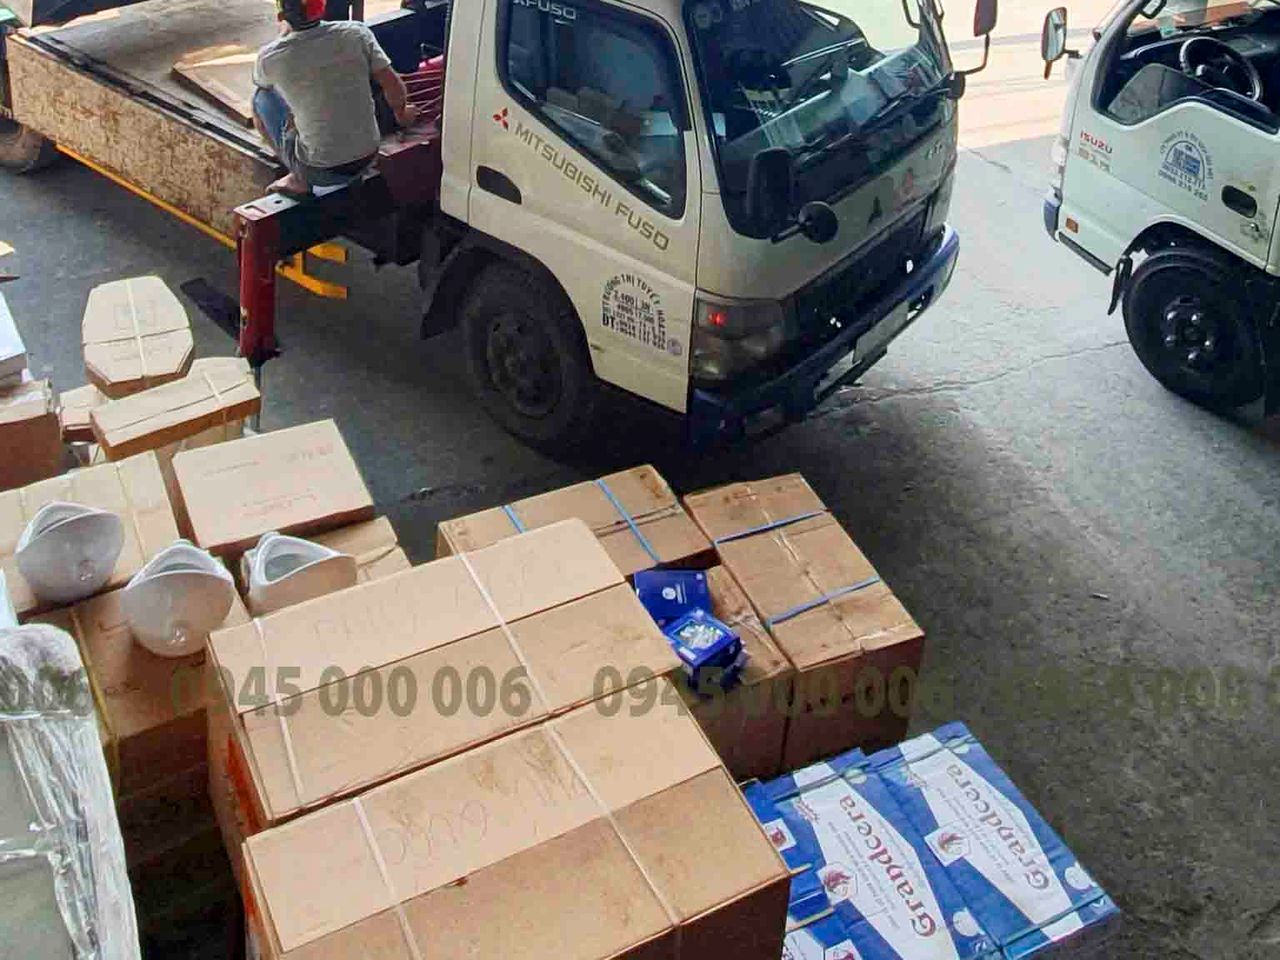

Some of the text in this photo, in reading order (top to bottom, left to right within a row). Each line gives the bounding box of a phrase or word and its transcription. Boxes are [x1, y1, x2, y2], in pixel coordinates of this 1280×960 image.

[515, 123, 670, 251] MITSUBISHI FUSO
[1080, 130, 1113, 154] ISUZU
[838, 793, 937, 938] Grandcera
[947, 762, 1051, 891] Grandcera
